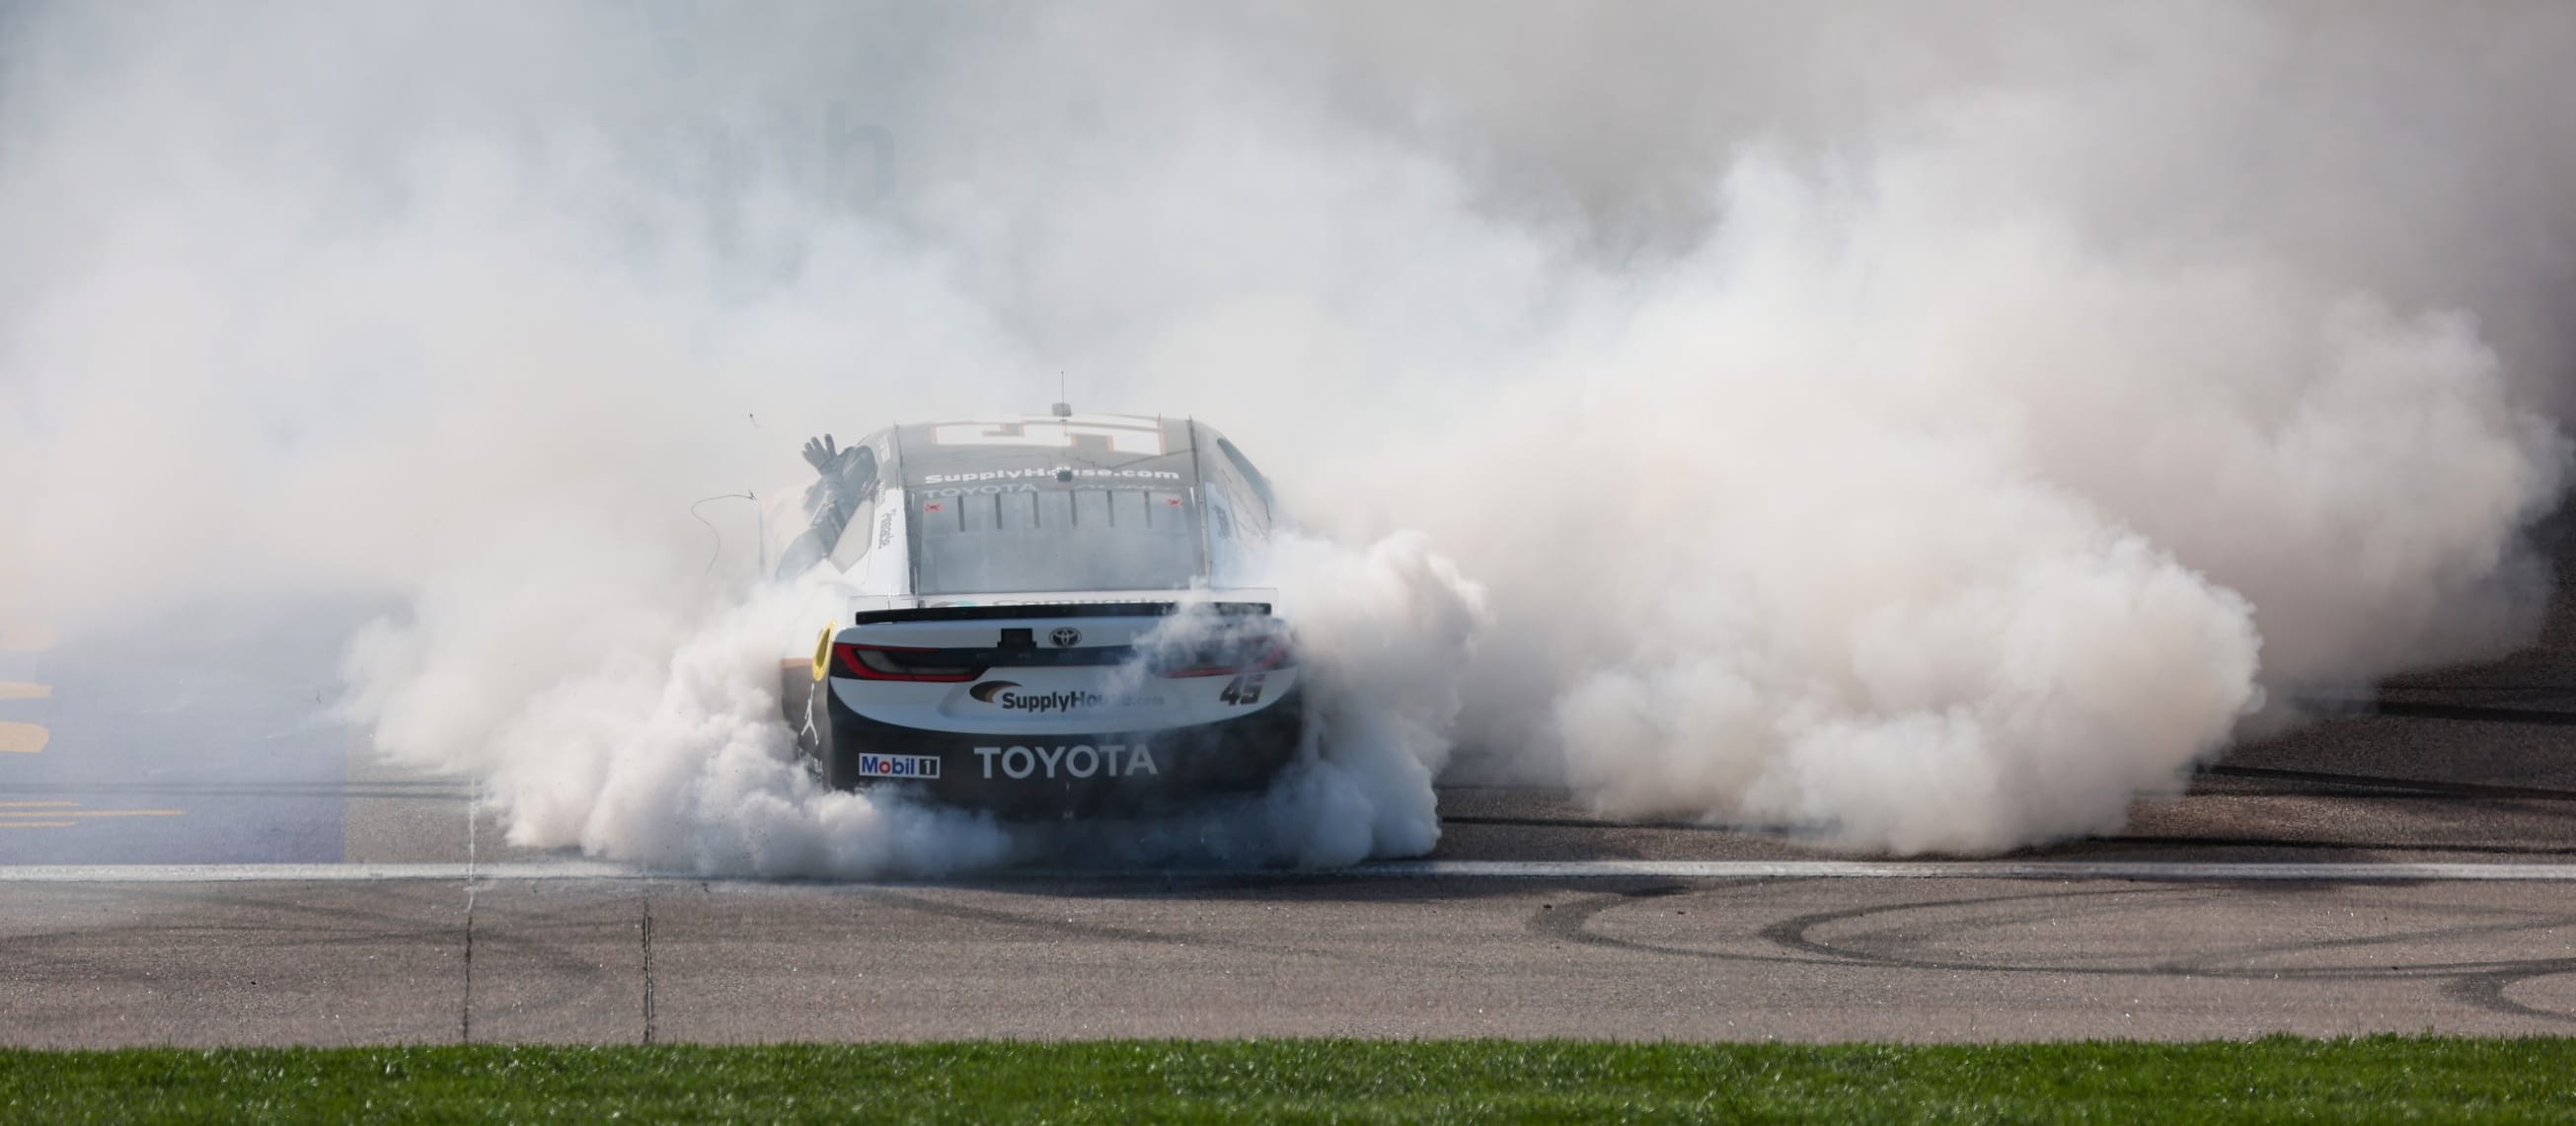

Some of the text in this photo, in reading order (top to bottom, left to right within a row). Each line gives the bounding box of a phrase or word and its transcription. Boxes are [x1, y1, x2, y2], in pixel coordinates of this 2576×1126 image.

[923, 483, 1039, 498] TOYOTA
[1002, 690, 1165, 713] SupplyHoue.com
[1219, 674, 1266, 706] 45
[861, 755, 915, 775] Mobil
[973, 744, 1160, 780] TOYOTA
